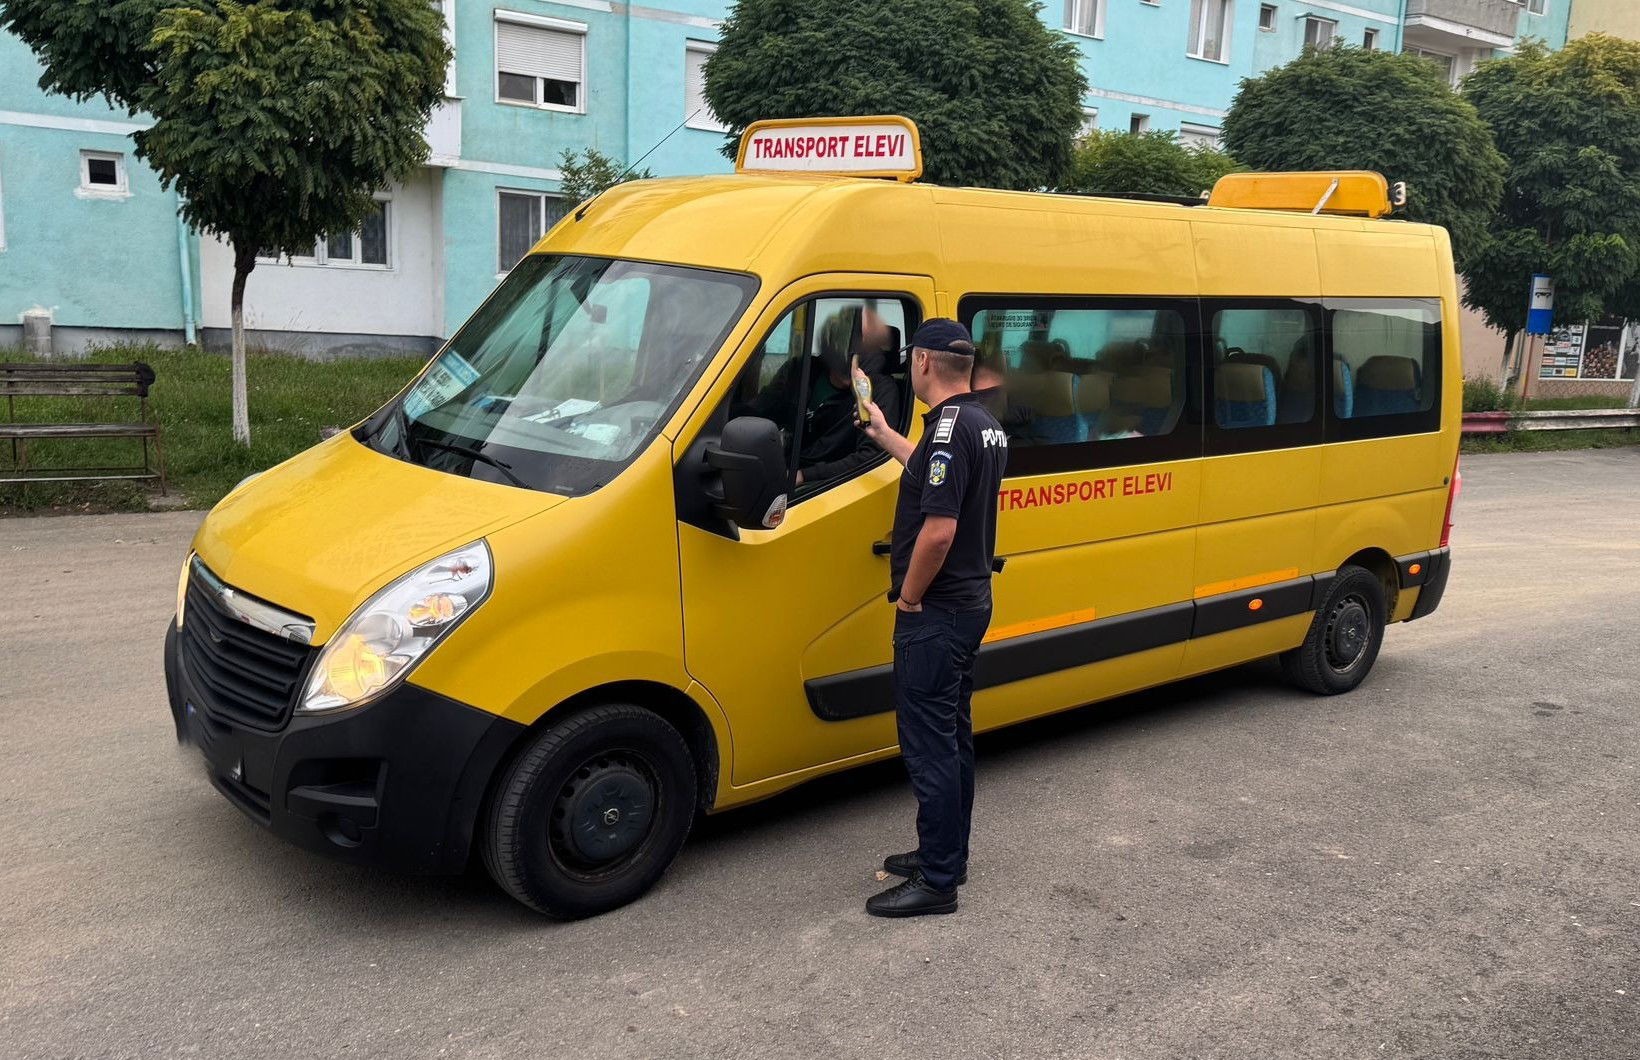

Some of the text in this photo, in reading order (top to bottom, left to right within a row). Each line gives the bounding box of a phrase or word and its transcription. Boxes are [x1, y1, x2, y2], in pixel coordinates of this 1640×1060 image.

[754, 135, 905, 158] TRANSPORT ELEVI
[998, 472, 1172, 511] TRANSPORT ELEVI
